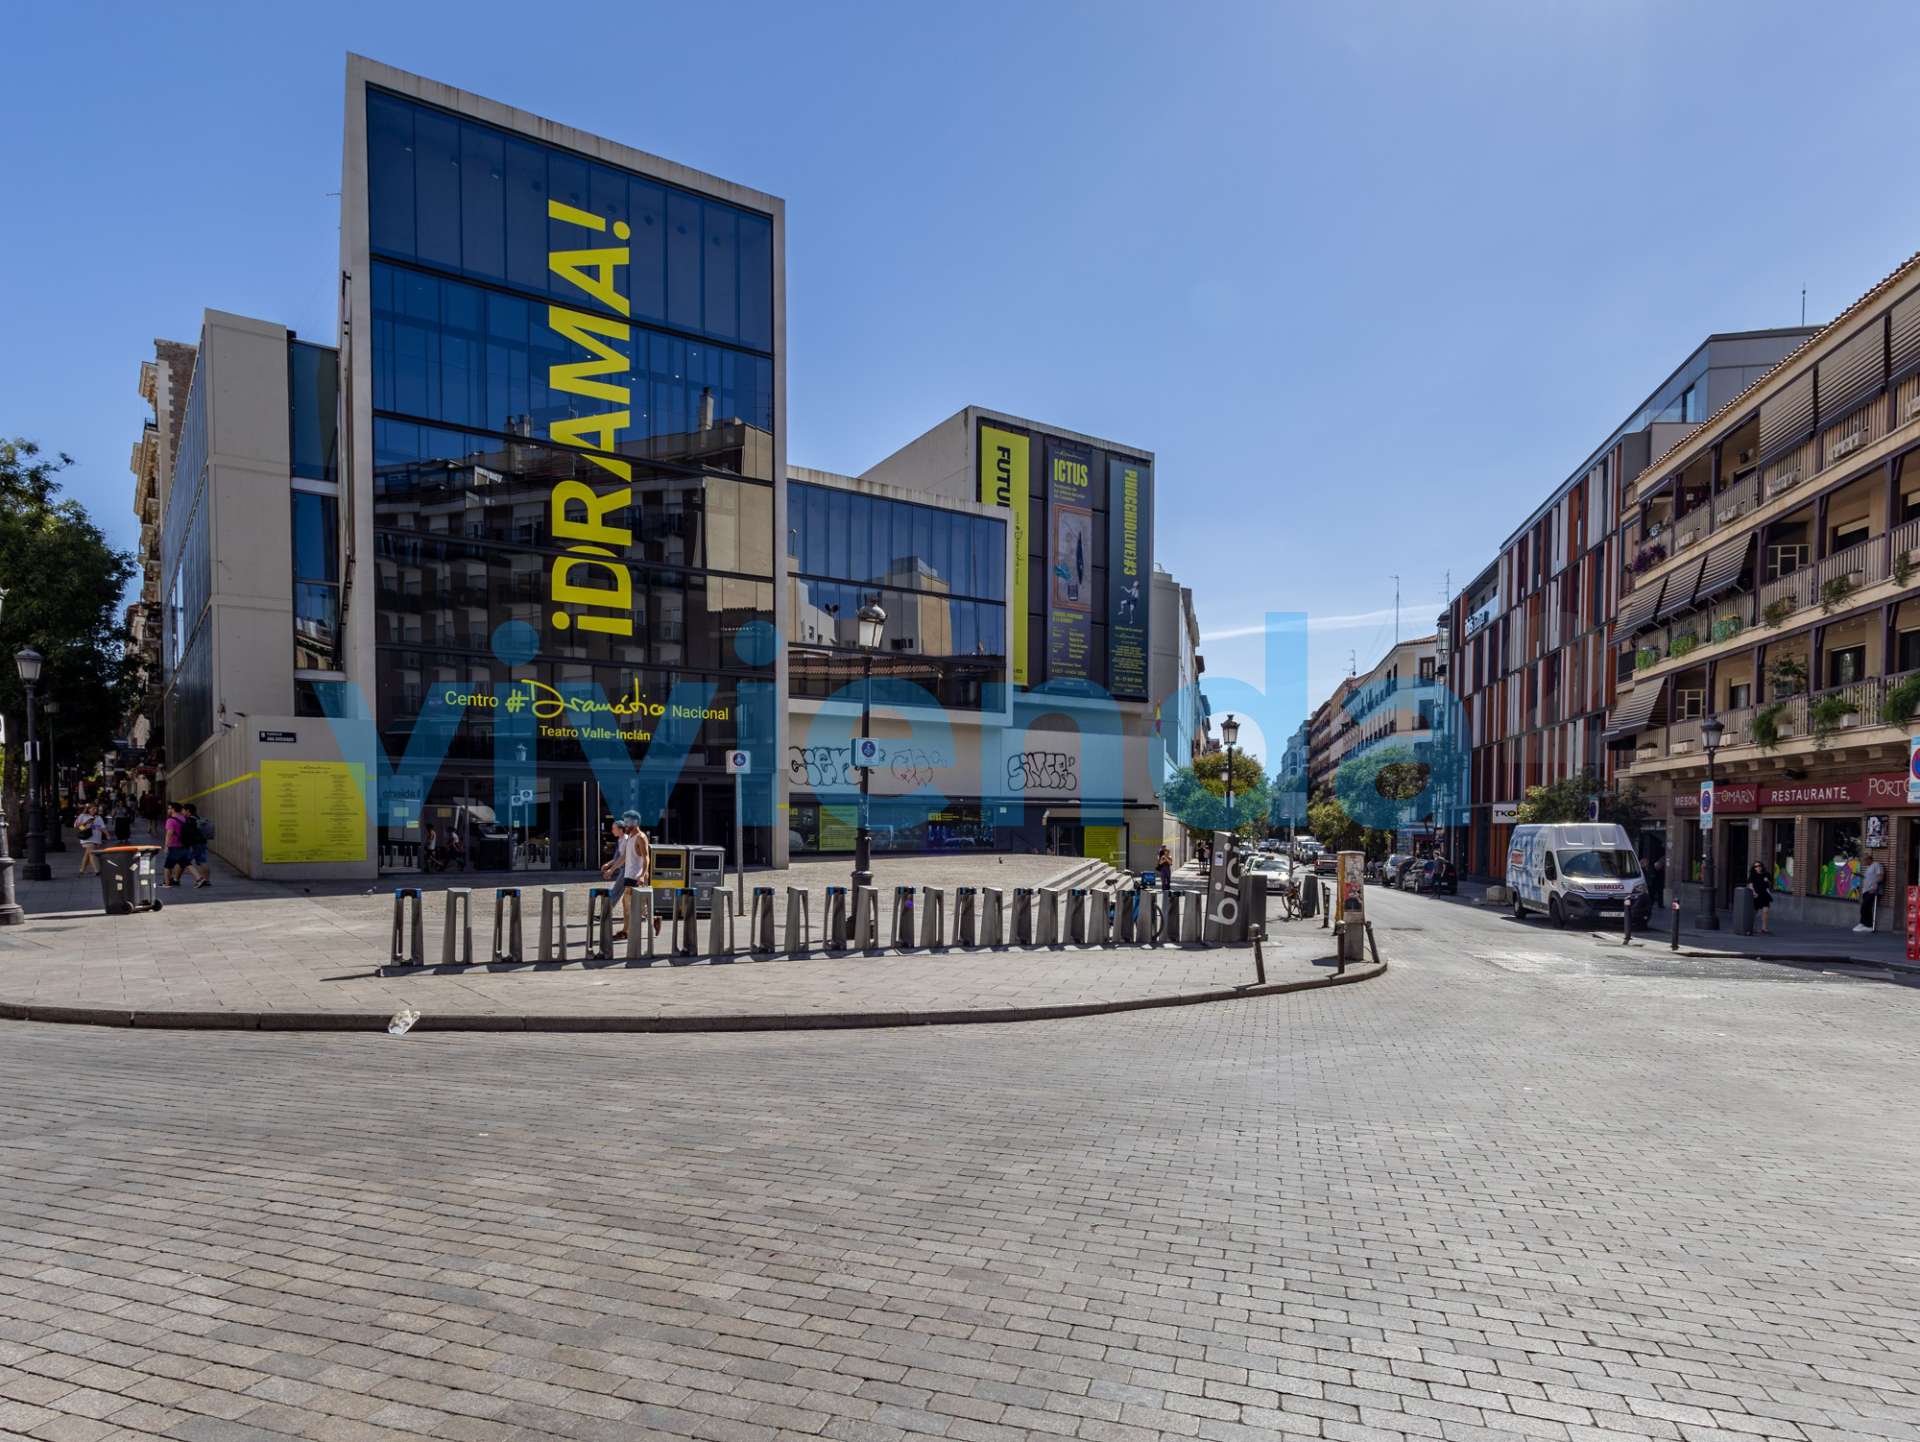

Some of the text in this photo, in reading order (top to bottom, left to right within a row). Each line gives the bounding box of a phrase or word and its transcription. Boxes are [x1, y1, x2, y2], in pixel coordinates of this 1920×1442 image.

[548, 199, 632, 637] ¡DRAMA!
[1054, 458, 1088, 488] ICTUS
[445, 690, 499, 708] Centro
[672, 704, 729, 721] Nacional
[539, 725, 651, 741] Teatro Valle-Inclán
